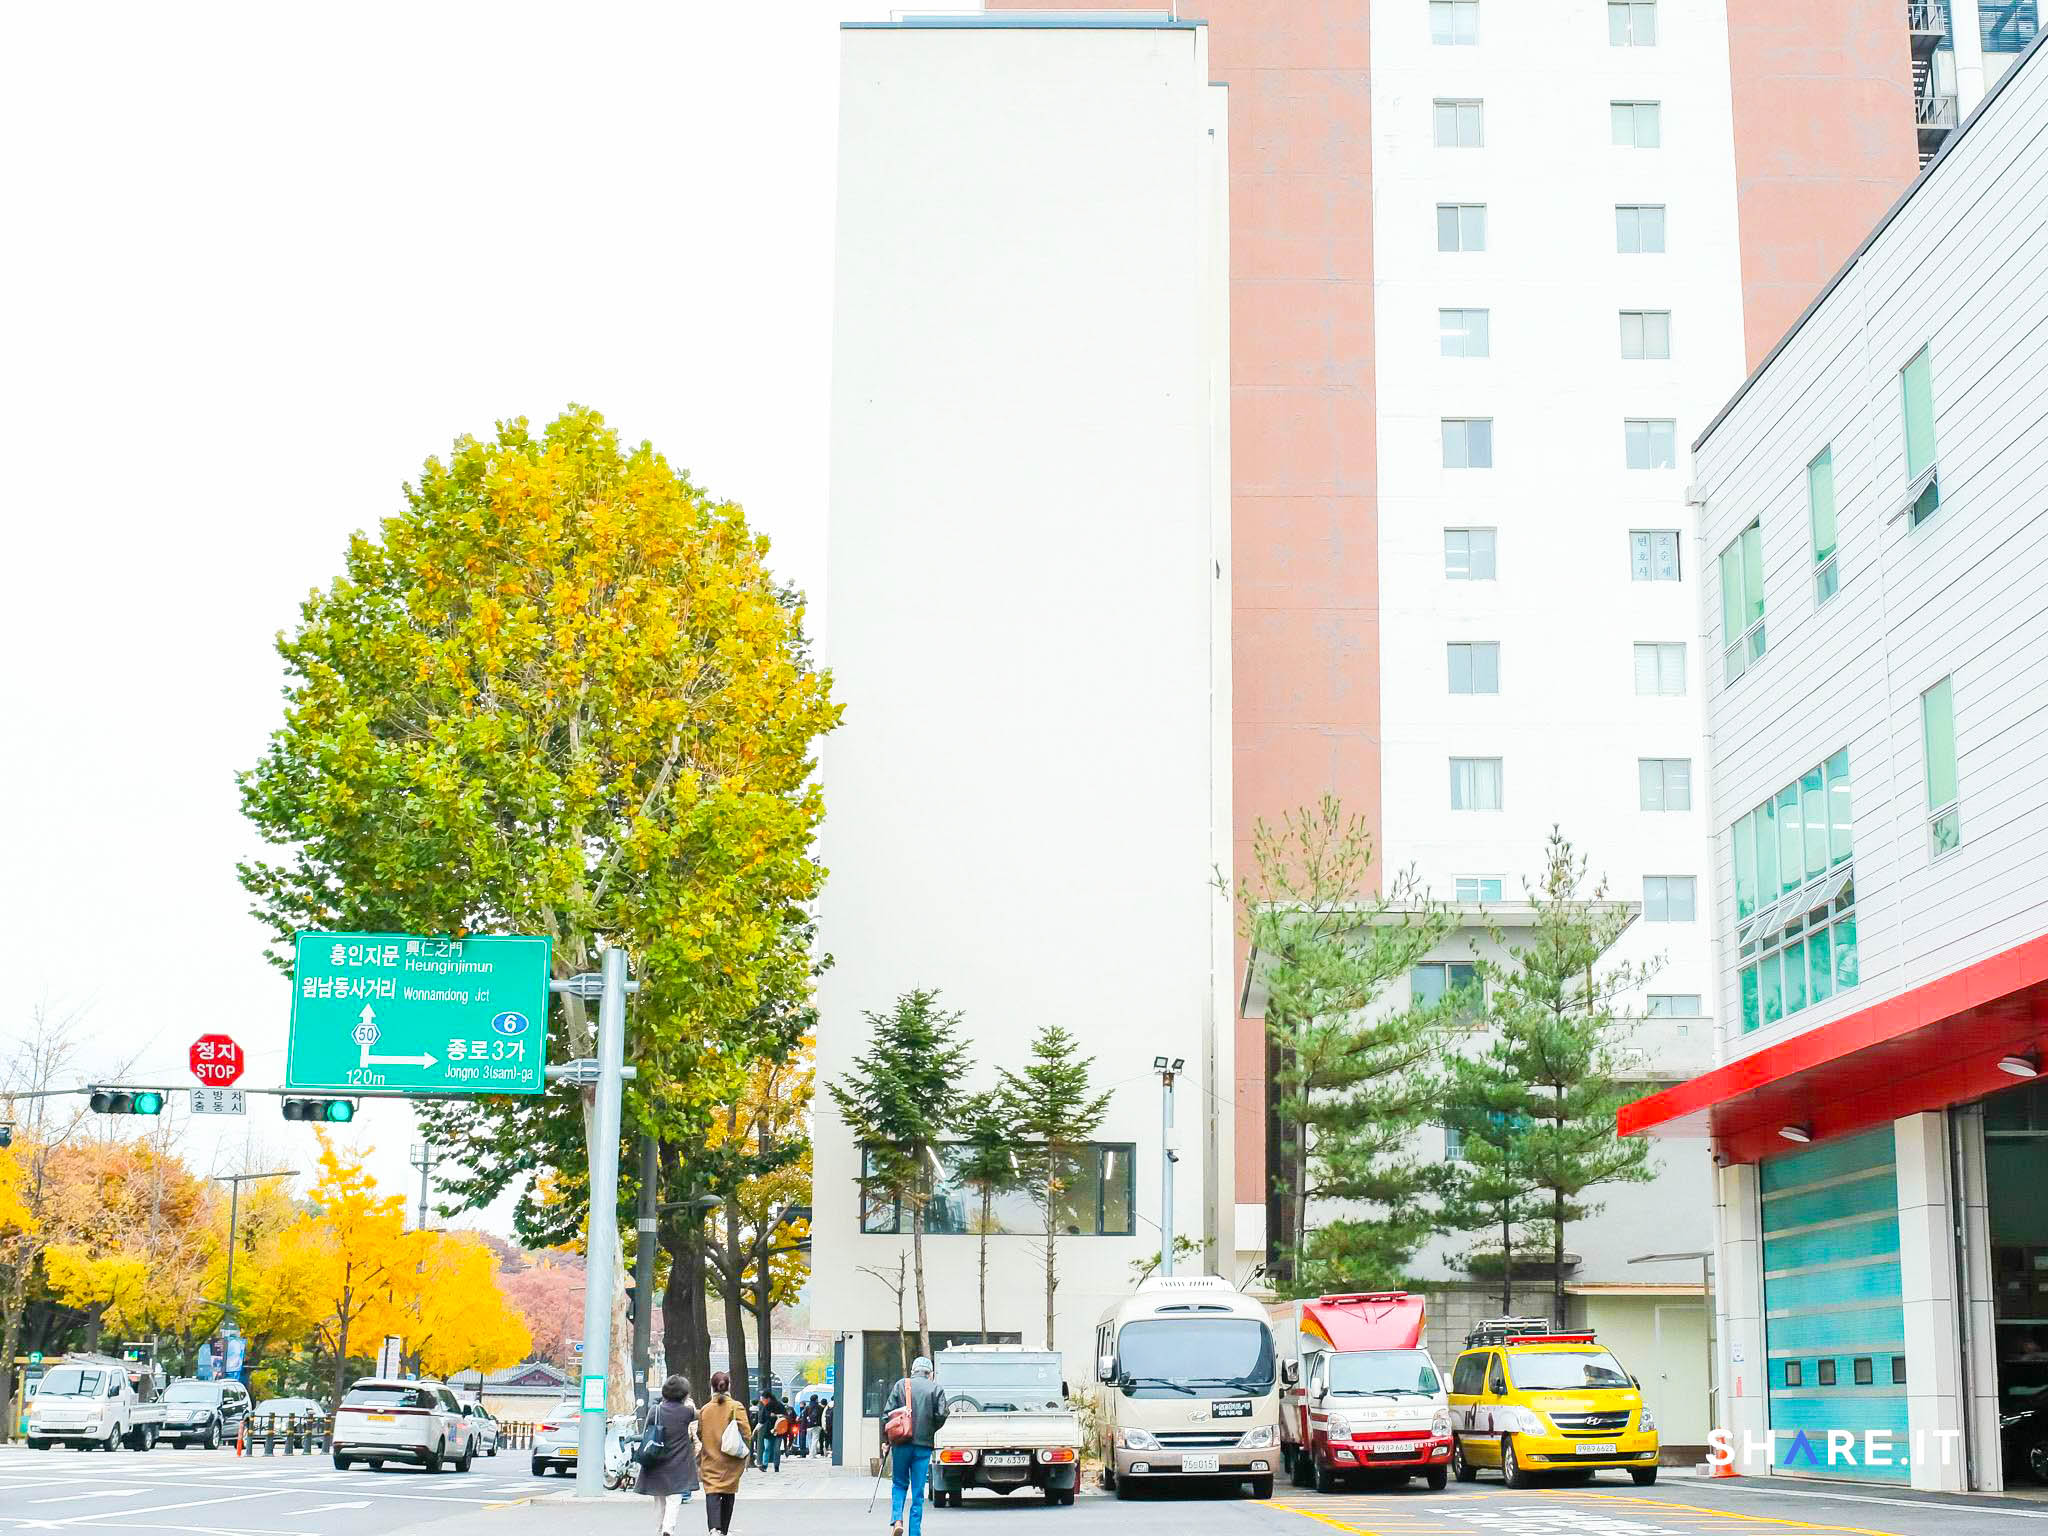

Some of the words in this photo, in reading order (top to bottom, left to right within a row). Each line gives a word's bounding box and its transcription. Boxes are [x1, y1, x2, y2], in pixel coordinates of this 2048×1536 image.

[329, 943, 400, 967] 흥인지문
[405, 940, 463, 957] 興仁之門
[404, 959, 494, 975] Heunginjimun
[403, 986, 469, 1005] Wonnamdong
[474, 987, 490, 1003] Jct
[503, 1014, 518, 1033] 6
[358, 1027, 374, 1042] 50
[196, 1041, 236, 1062] 정지
[446, 1038, 526, 1062] 종로3가
[196, 1063, 236, 1079] STOP
[345, 1068, 386, 1086] 120m
[444, 1064, 480, 1081] Jongno
[482, 1065, 533, 1082] 3(sam)-ga
